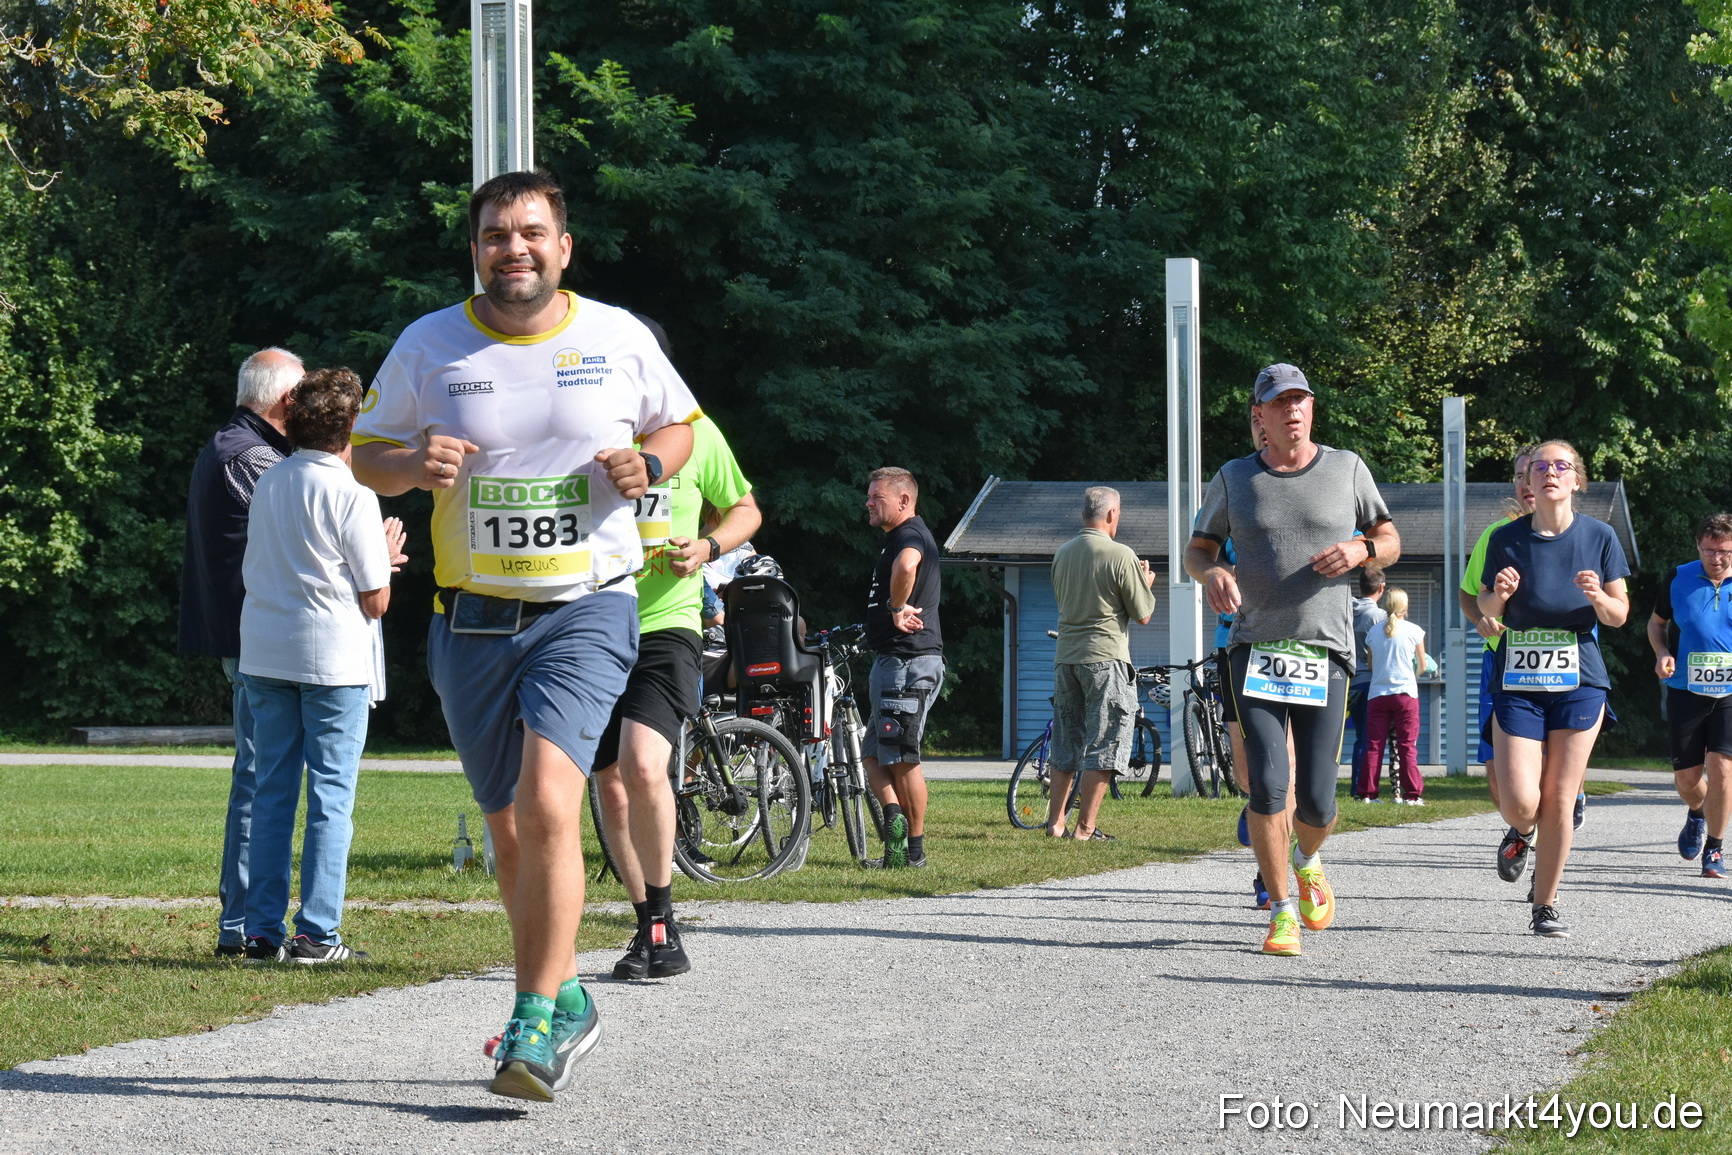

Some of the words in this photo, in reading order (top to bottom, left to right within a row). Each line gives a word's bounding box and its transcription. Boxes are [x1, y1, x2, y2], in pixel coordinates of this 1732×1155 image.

[556, 352, 580, 368] 20
[583, 356, 605, 364] JAHRE
[556, 367, 613, 378] Neumarkter
[449, 381, 494, 393] BOCK
[557, 377, 604, 388] Stadtlauf
[478, 478, 581, 506] BOCK
[484, 513, 579, 549] 1383
[1512, 630, 1571, 644] BOCK
[1514, 650, 1570, 670] 2075
[1257, 655, 1319, 681] 2025
[1694, 668, 1732, 682] 2052
[1518, 675, 1563, 684] ANNIKA
[1260, 682, 1311, 697] JÜRGEN
